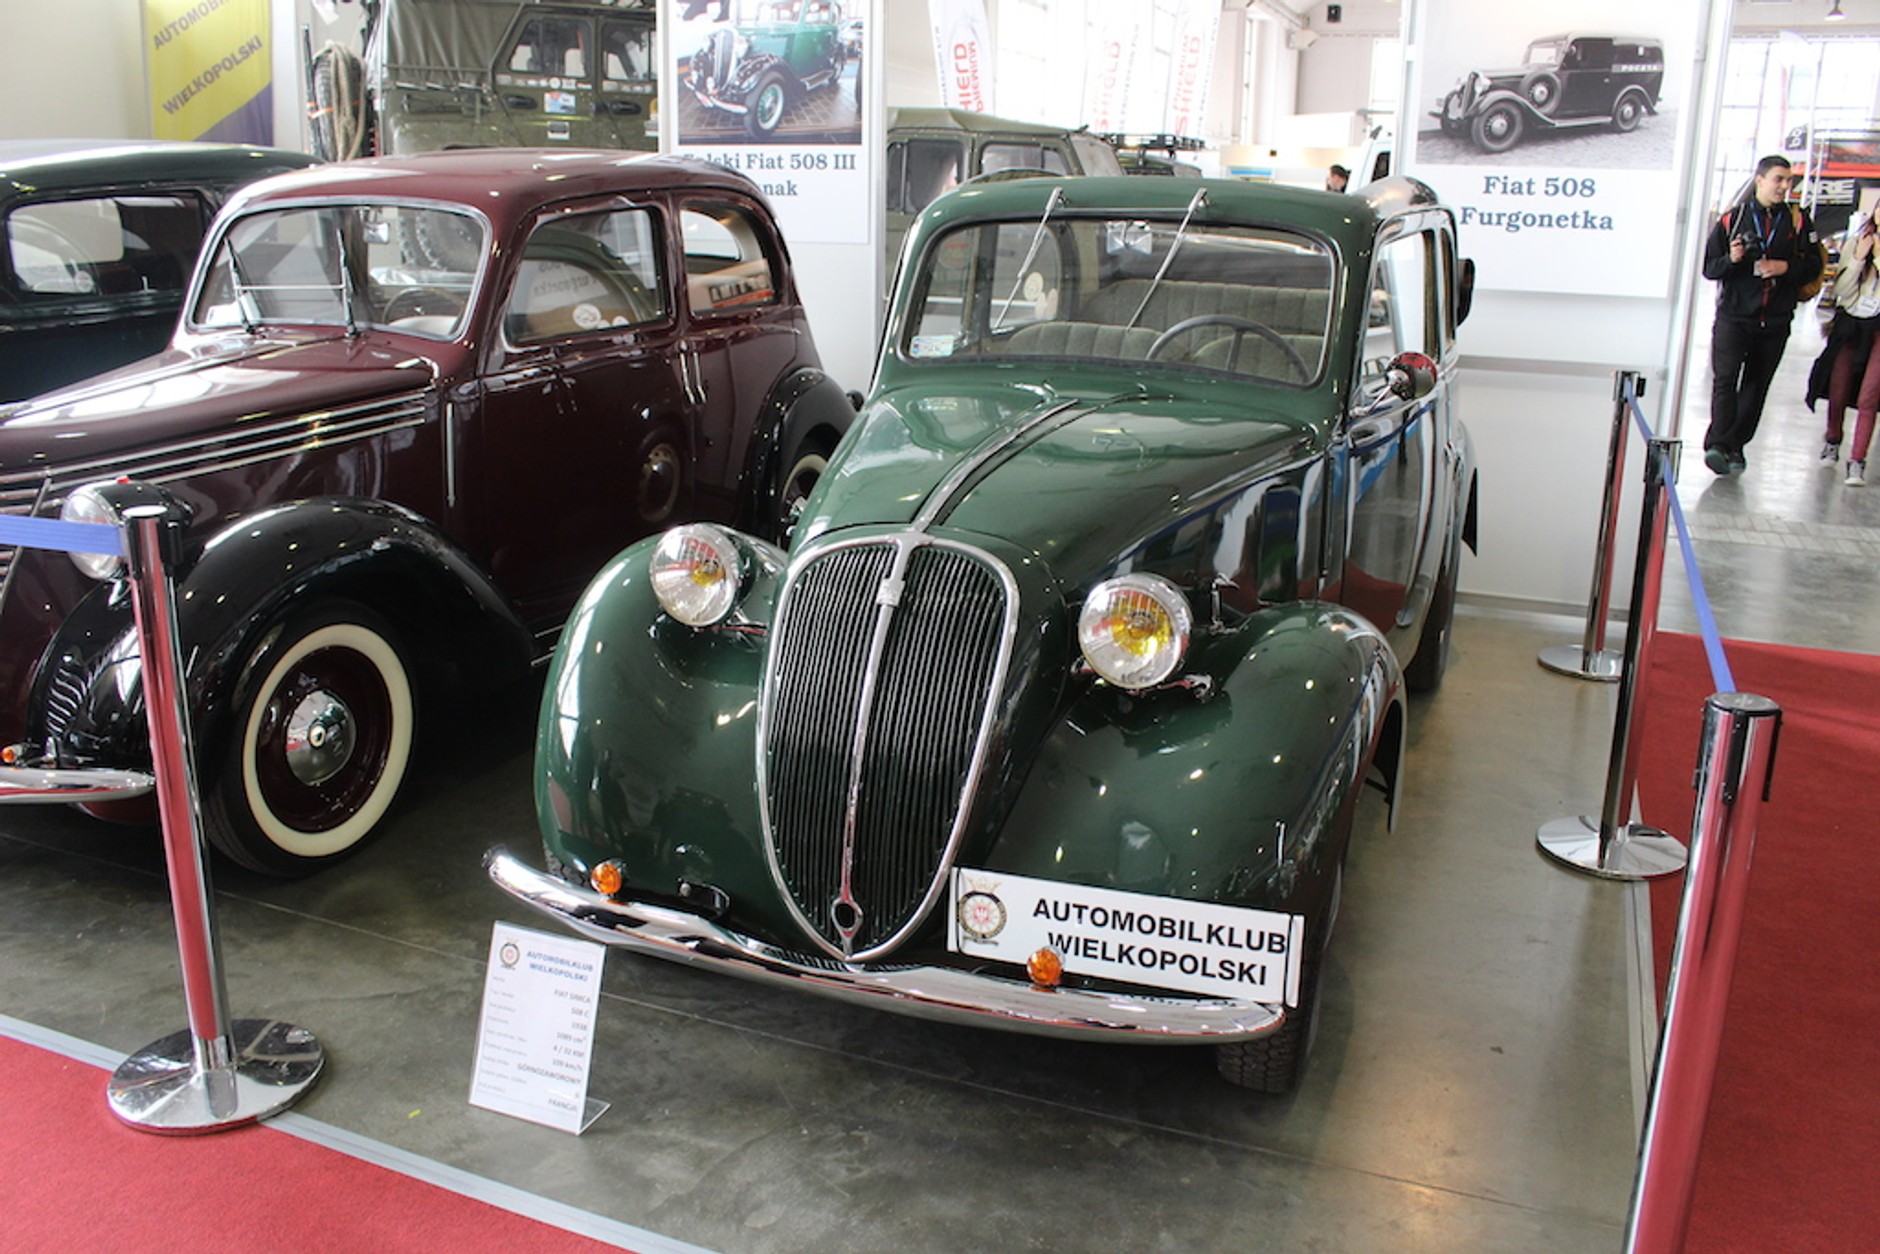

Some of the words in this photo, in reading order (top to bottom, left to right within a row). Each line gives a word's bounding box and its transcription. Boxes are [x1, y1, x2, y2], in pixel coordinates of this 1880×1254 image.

[162, 35, 263, 115] WIELKOPOLSKI
[1175, 36, 1201, 135] SHIELD
[746, 153, 785, 170] Fiat
[790, 154, 828, 170] 508
[833, 154, 857, 170] III
[1483, 175, 1536, 196] Fiat
[1544, 176, 1596, 198] 508
[1460, 207, 1614, 233] Furgonetka
[1033, 898, 1287, 955] AUTOMOBILKLUB
[526, 950, 594, 972] AUTOMOBILKLUB
[1048, 932, 1267, 985] WIELKOPOLSKI
[529, 963, 589, 982] WIELKOPOLSKI
